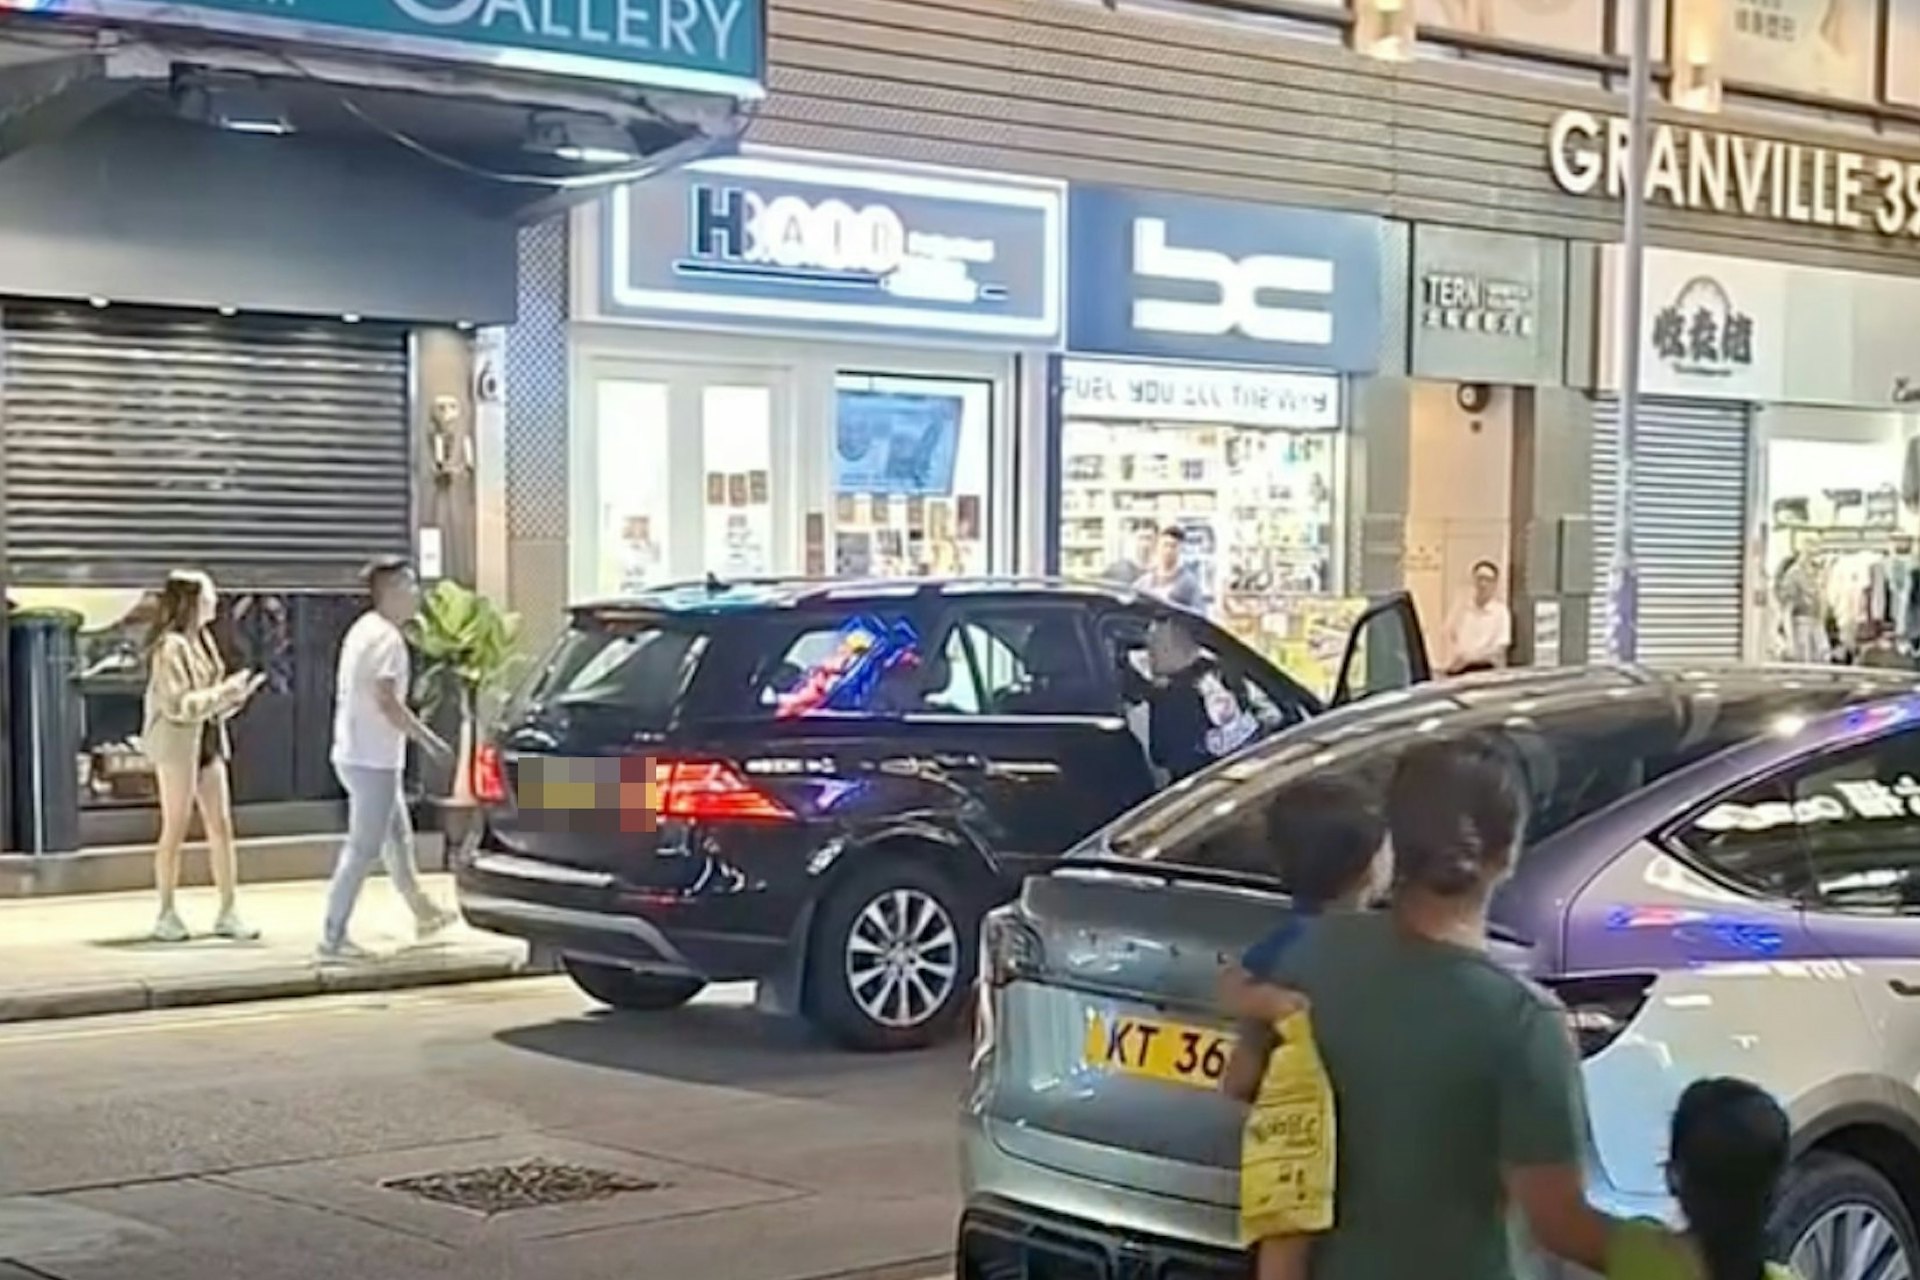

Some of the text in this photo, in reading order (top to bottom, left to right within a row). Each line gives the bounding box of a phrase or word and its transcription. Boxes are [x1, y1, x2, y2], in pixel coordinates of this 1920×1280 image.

[1551, 109, 1863, 227] GRANVILLE
[1423, 275, 1481, 307] TERN
[1106, 1020, 1160, 1067] KT
